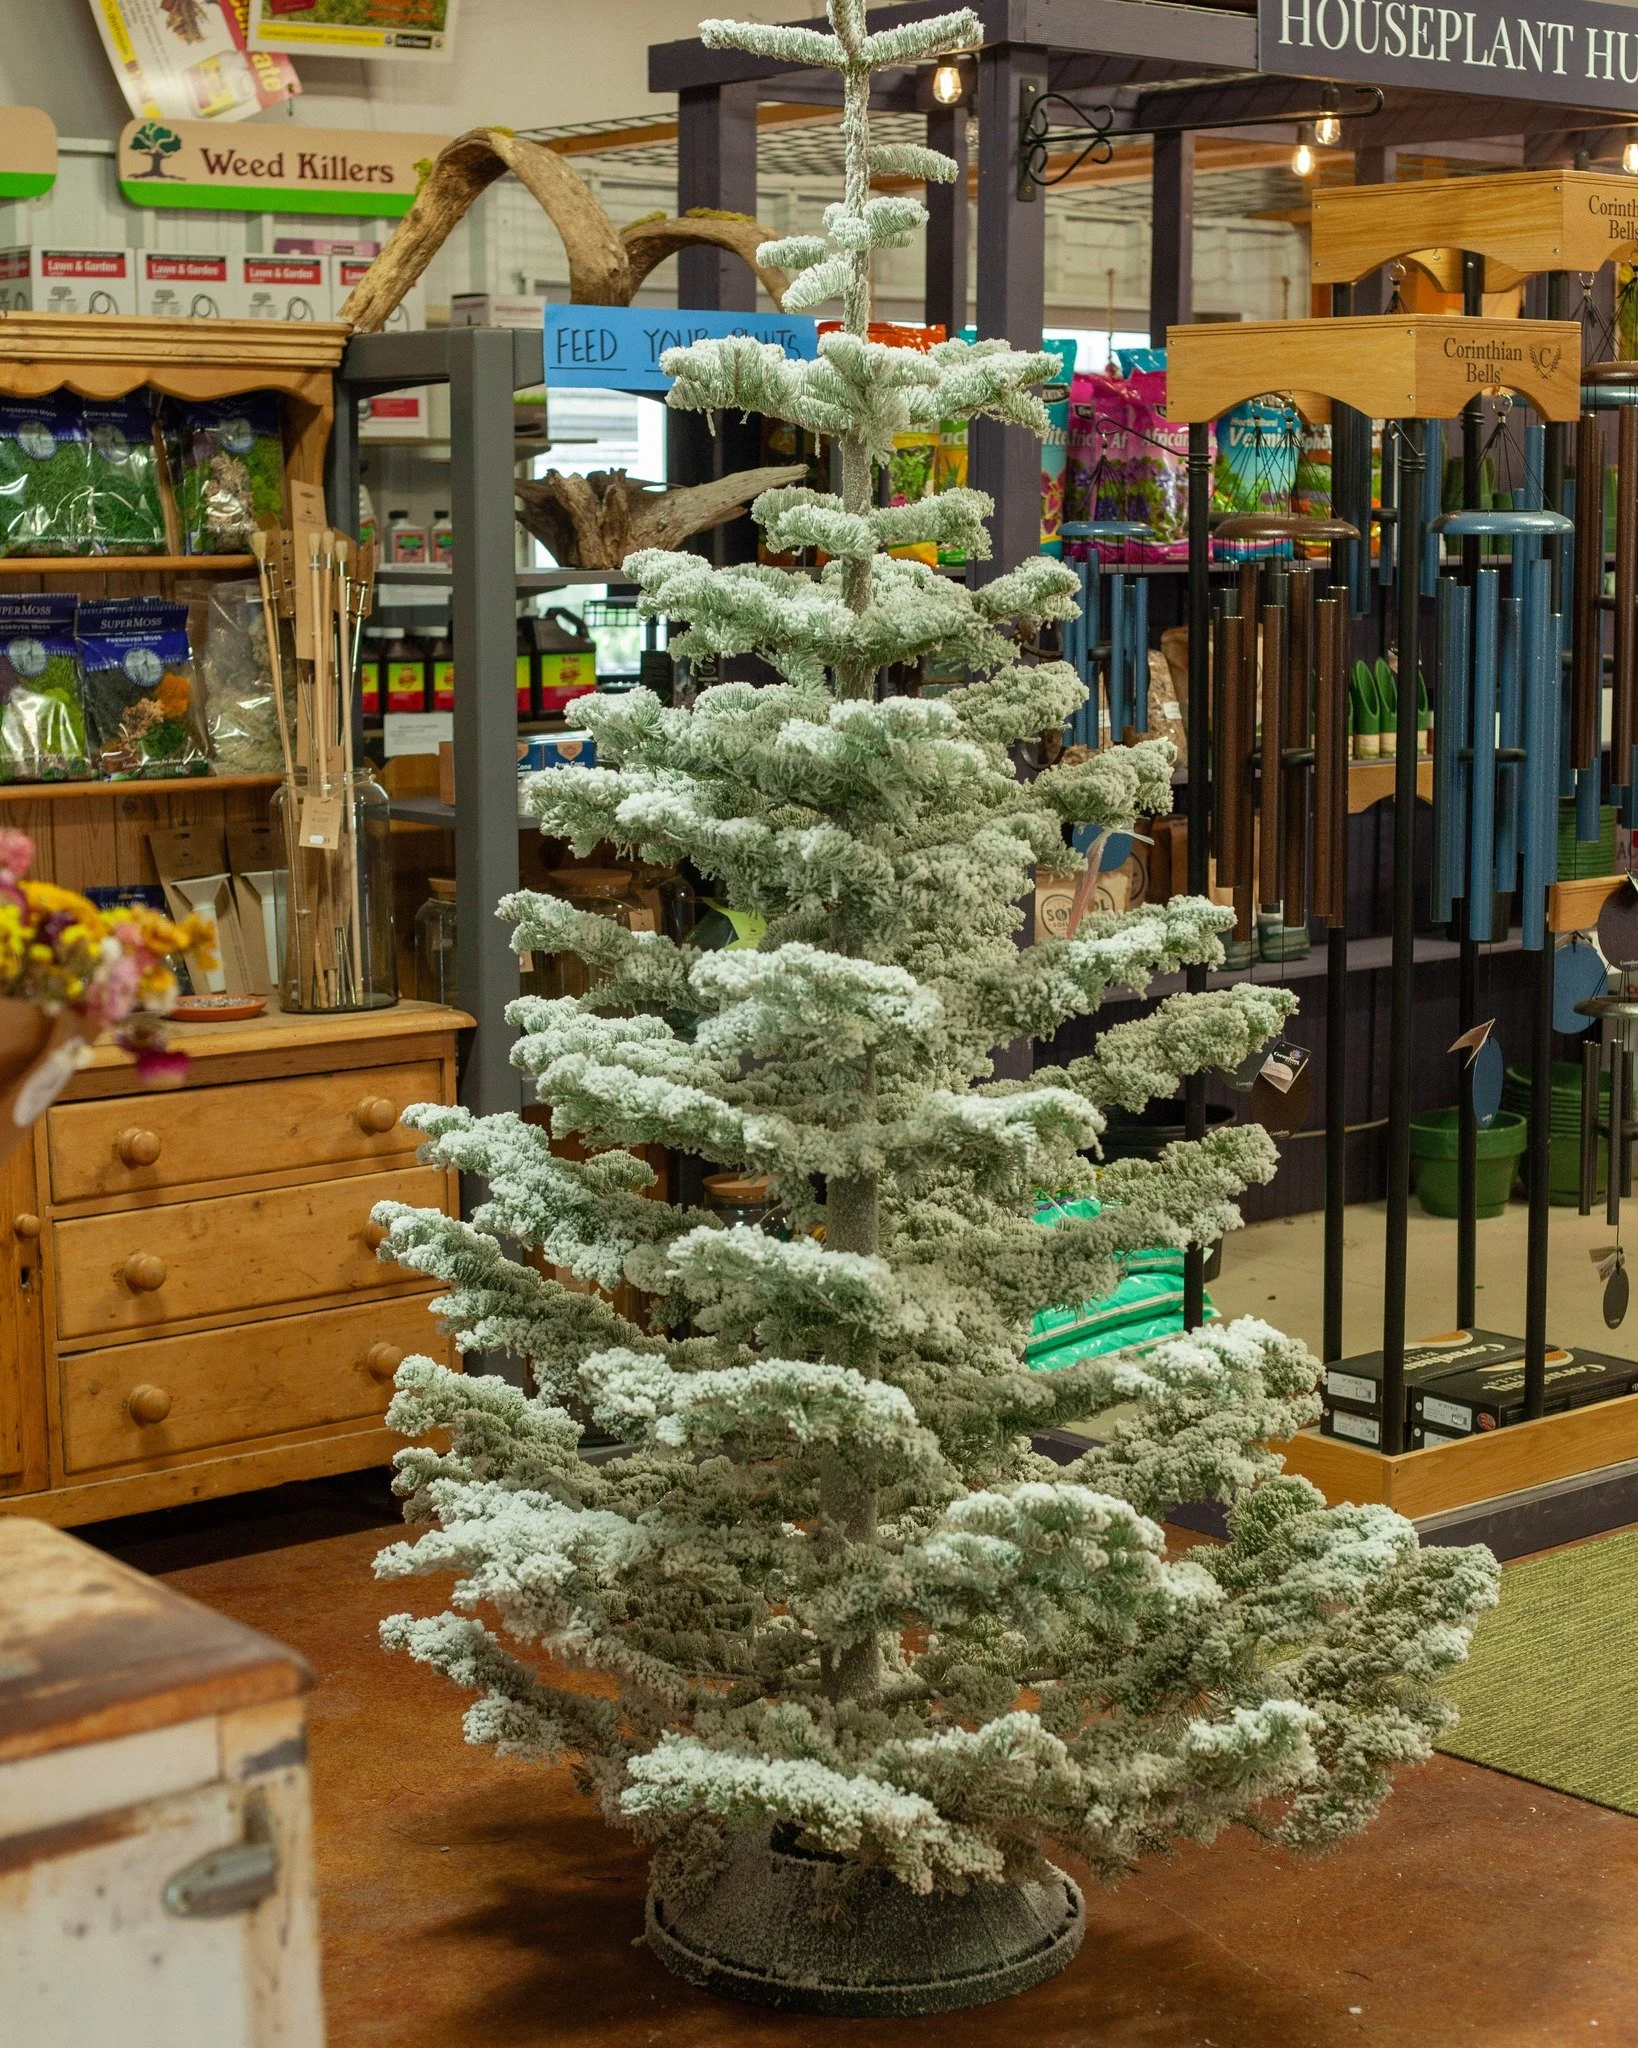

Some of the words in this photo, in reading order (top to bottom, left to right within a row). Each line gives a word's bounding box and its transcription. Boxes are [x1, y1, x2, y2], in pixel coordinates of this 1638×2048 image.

[1278, 0, 1574, 75] HOUSEPLANT
[199, 147, 284, 178] Weed
[297, 152, 395, 184] Killers
[48, 261, 73, 272] Lawn
[84, 262, 118, 273] Garden
[152, 264, 176, 275] Lawn
[187, 265, 219, 276] Garden
[250, 267, 272, 279] Lawn
[283, 268, 314, 280] Garden
[557, 327, 617, 364] FEED
[1443, 337, 1523, 361] Corinthian
[1466, 362, 1501, 383] Bells
